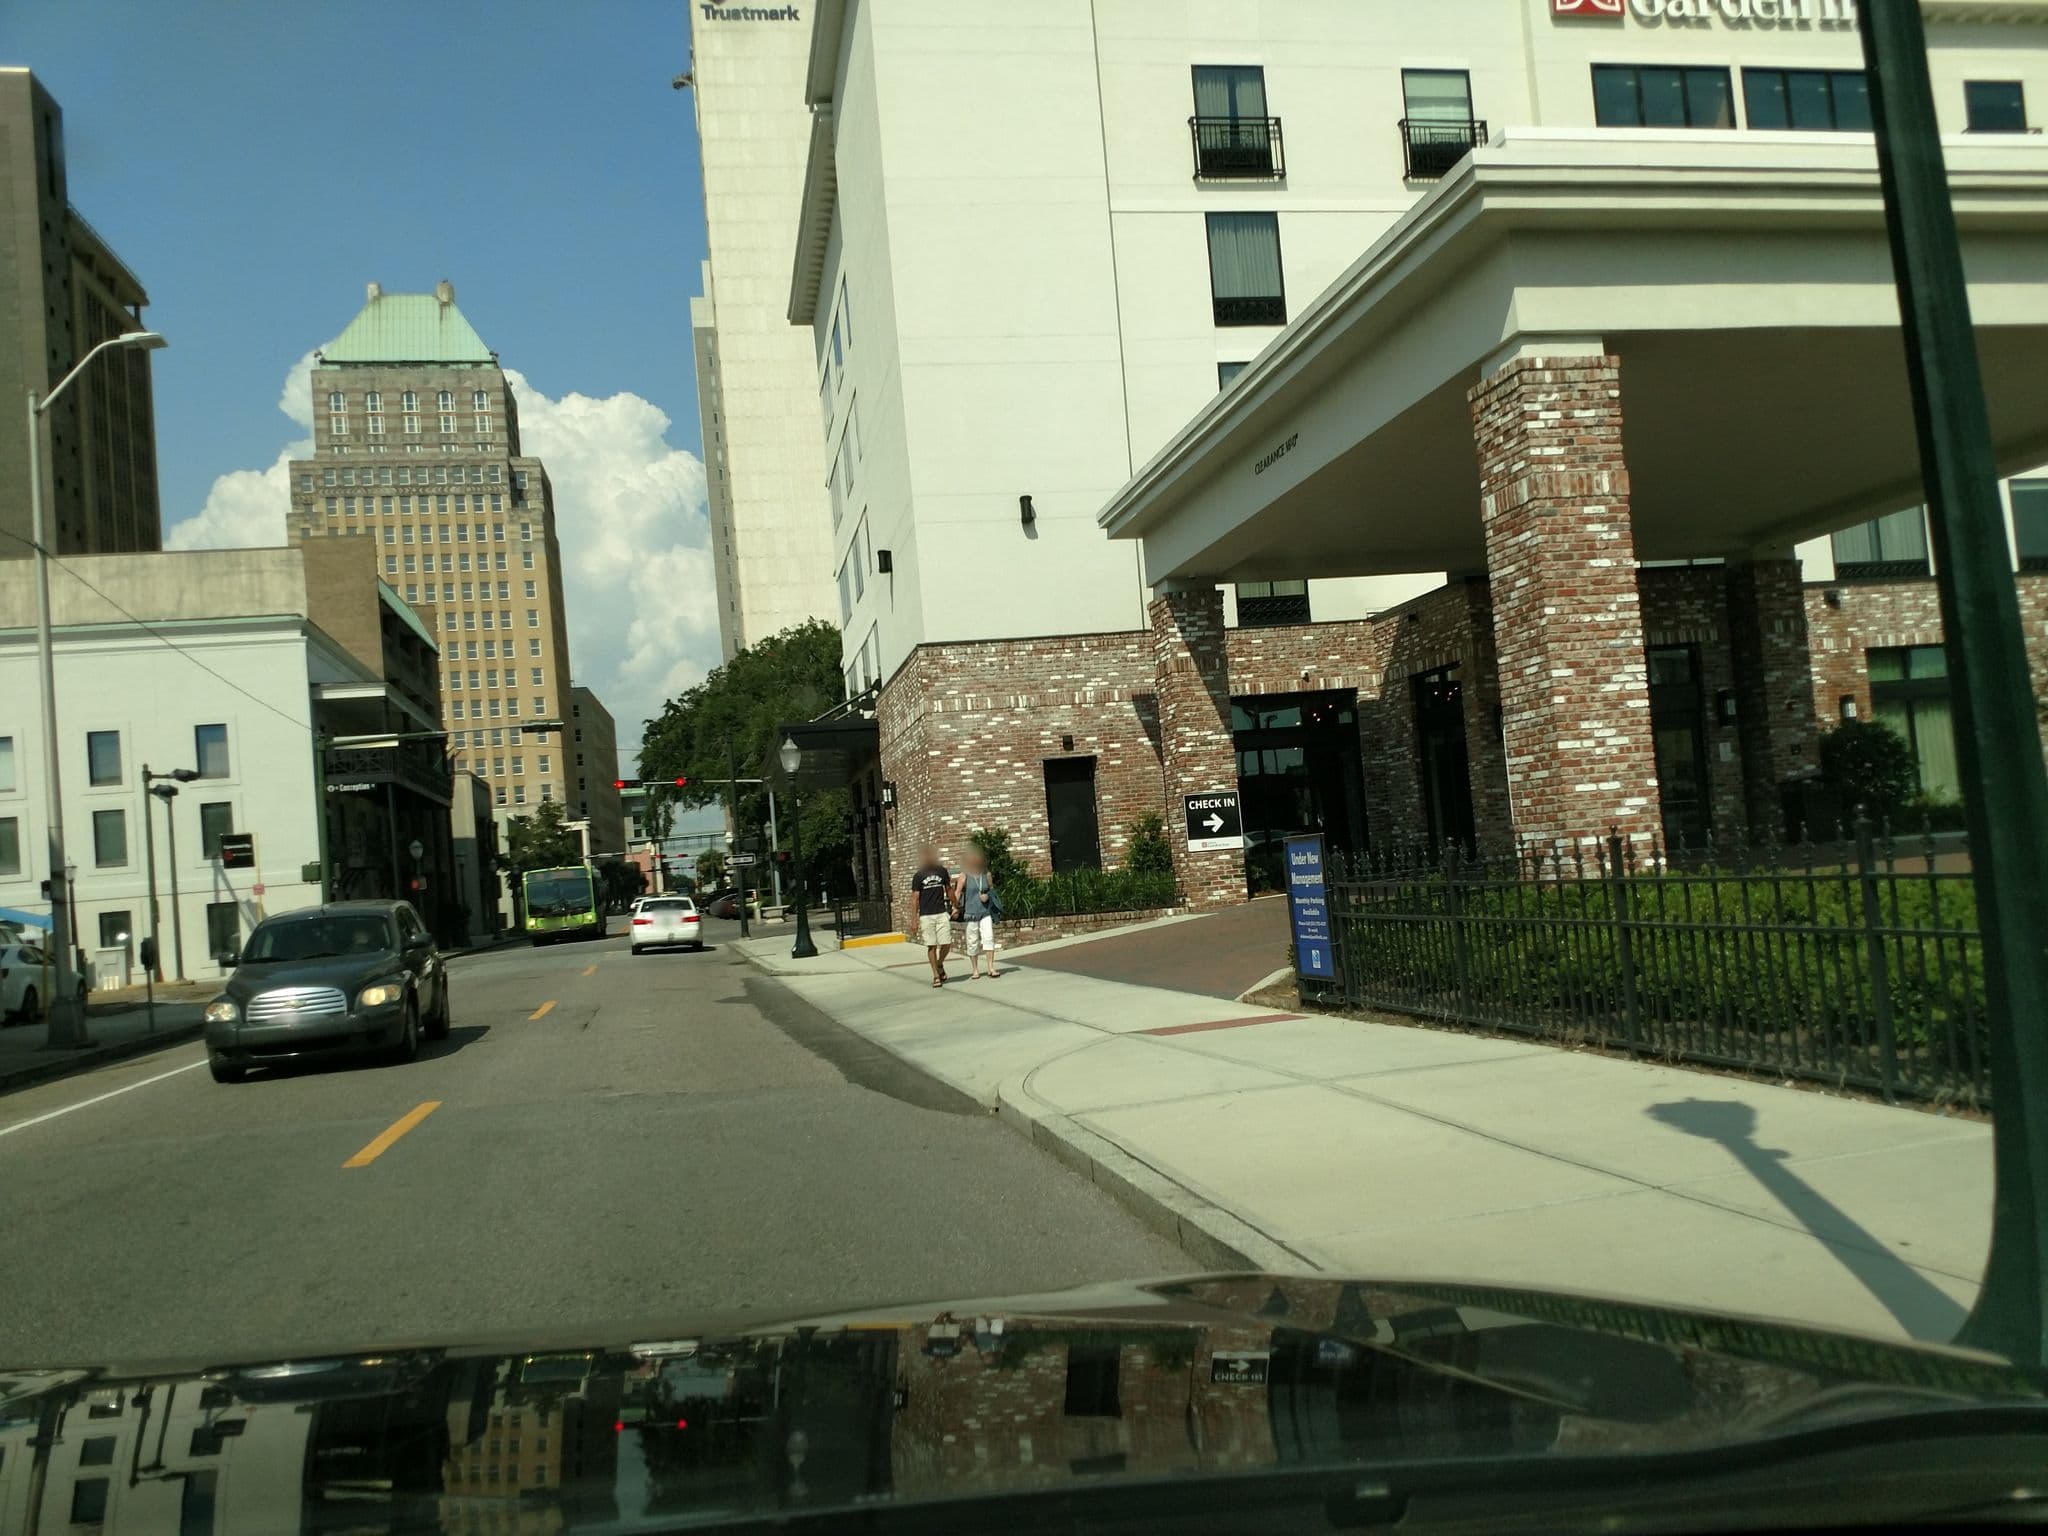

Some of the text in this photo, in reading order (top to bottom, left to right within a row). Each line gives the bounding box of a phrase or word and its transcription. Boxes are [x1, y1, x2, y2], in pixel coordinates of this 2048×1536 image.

[700, 4, 800, 21] Trustmark
[1188, 797, 1235, 809] CHECK IN
[1291, 851, 1319, 866] Under New
[1291, 872, 1323, 887] Management
